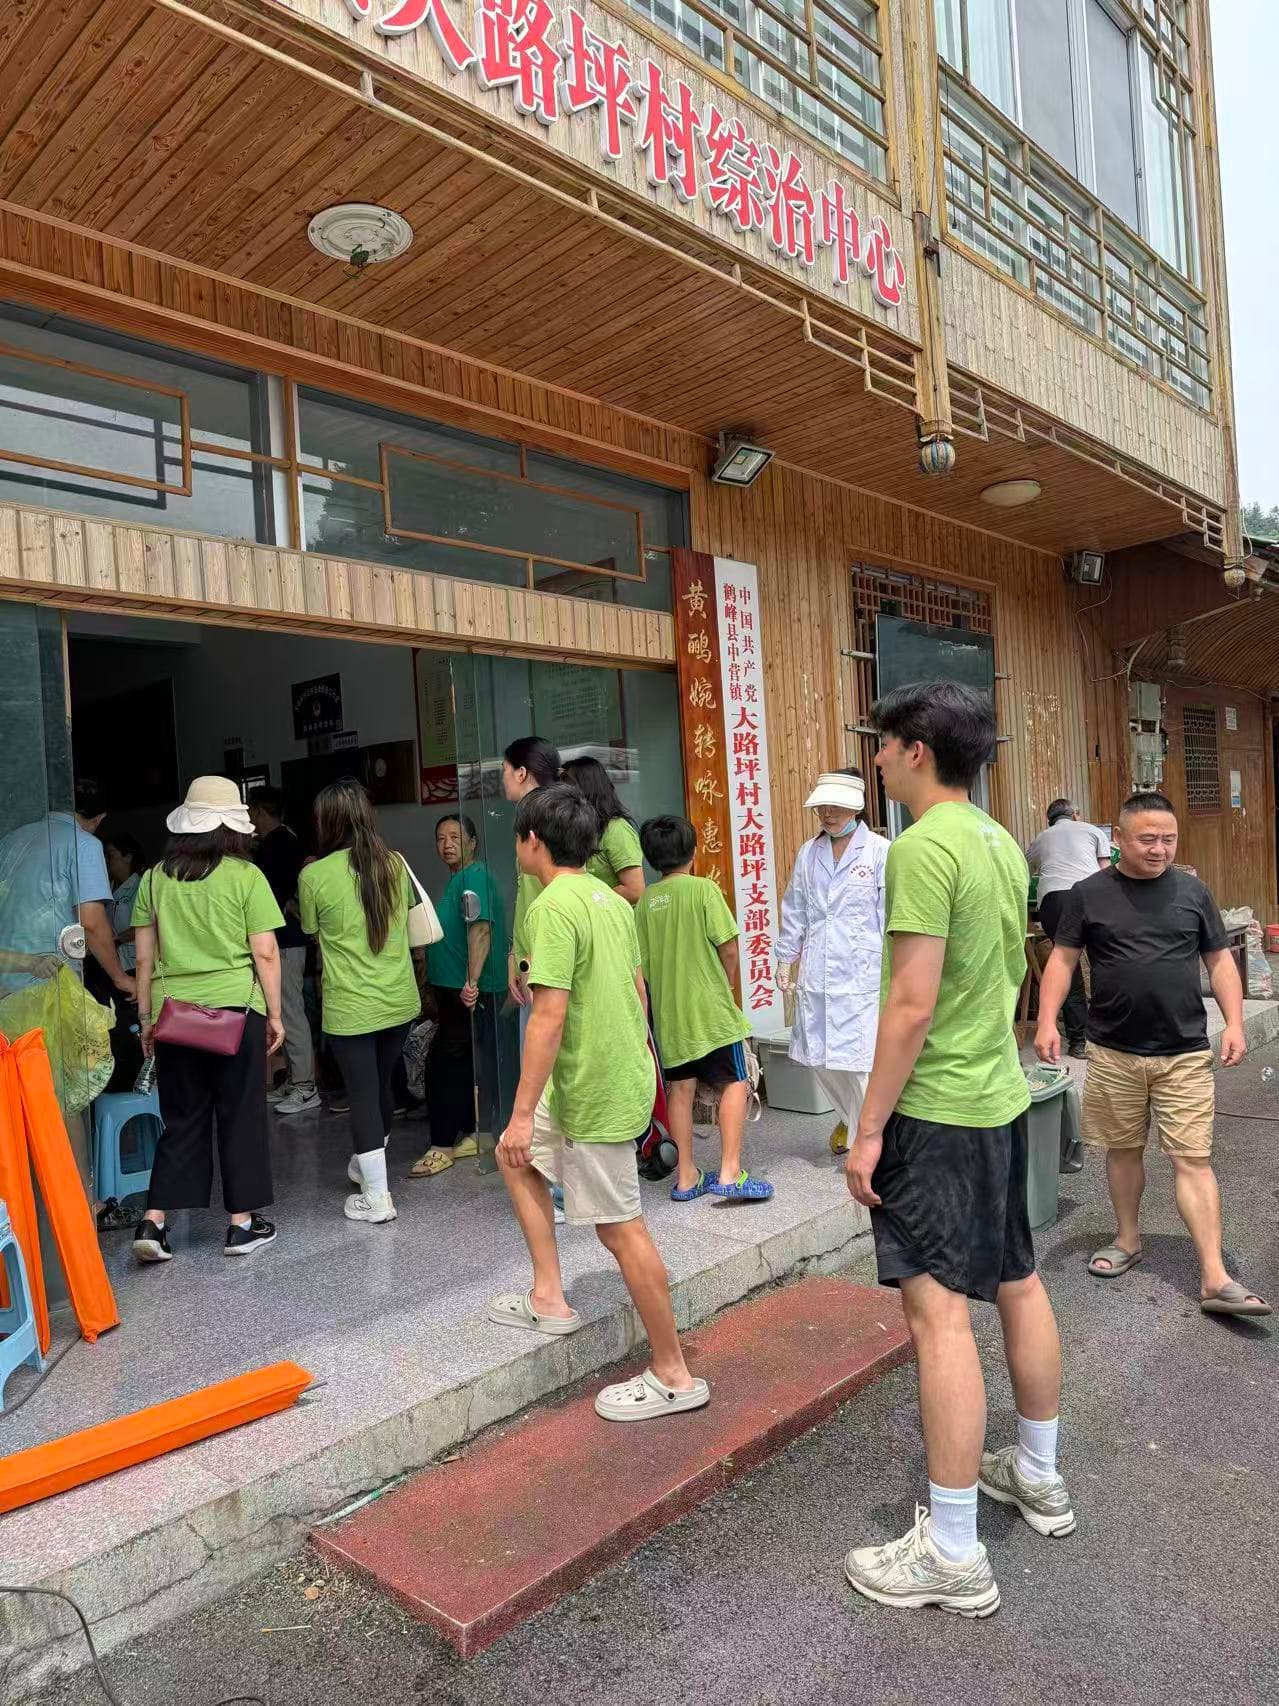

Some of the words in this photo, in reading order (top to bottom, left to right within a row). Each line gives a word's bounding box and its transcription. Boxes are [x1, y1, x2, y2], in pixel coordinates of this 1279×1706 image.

[723, 583, 743, 701] 鹤峰县中营镇
[739, 586, 758, 703] 中国共产党
[731, 706, 775, 1010] 大路坪村大路坪支部委员会
